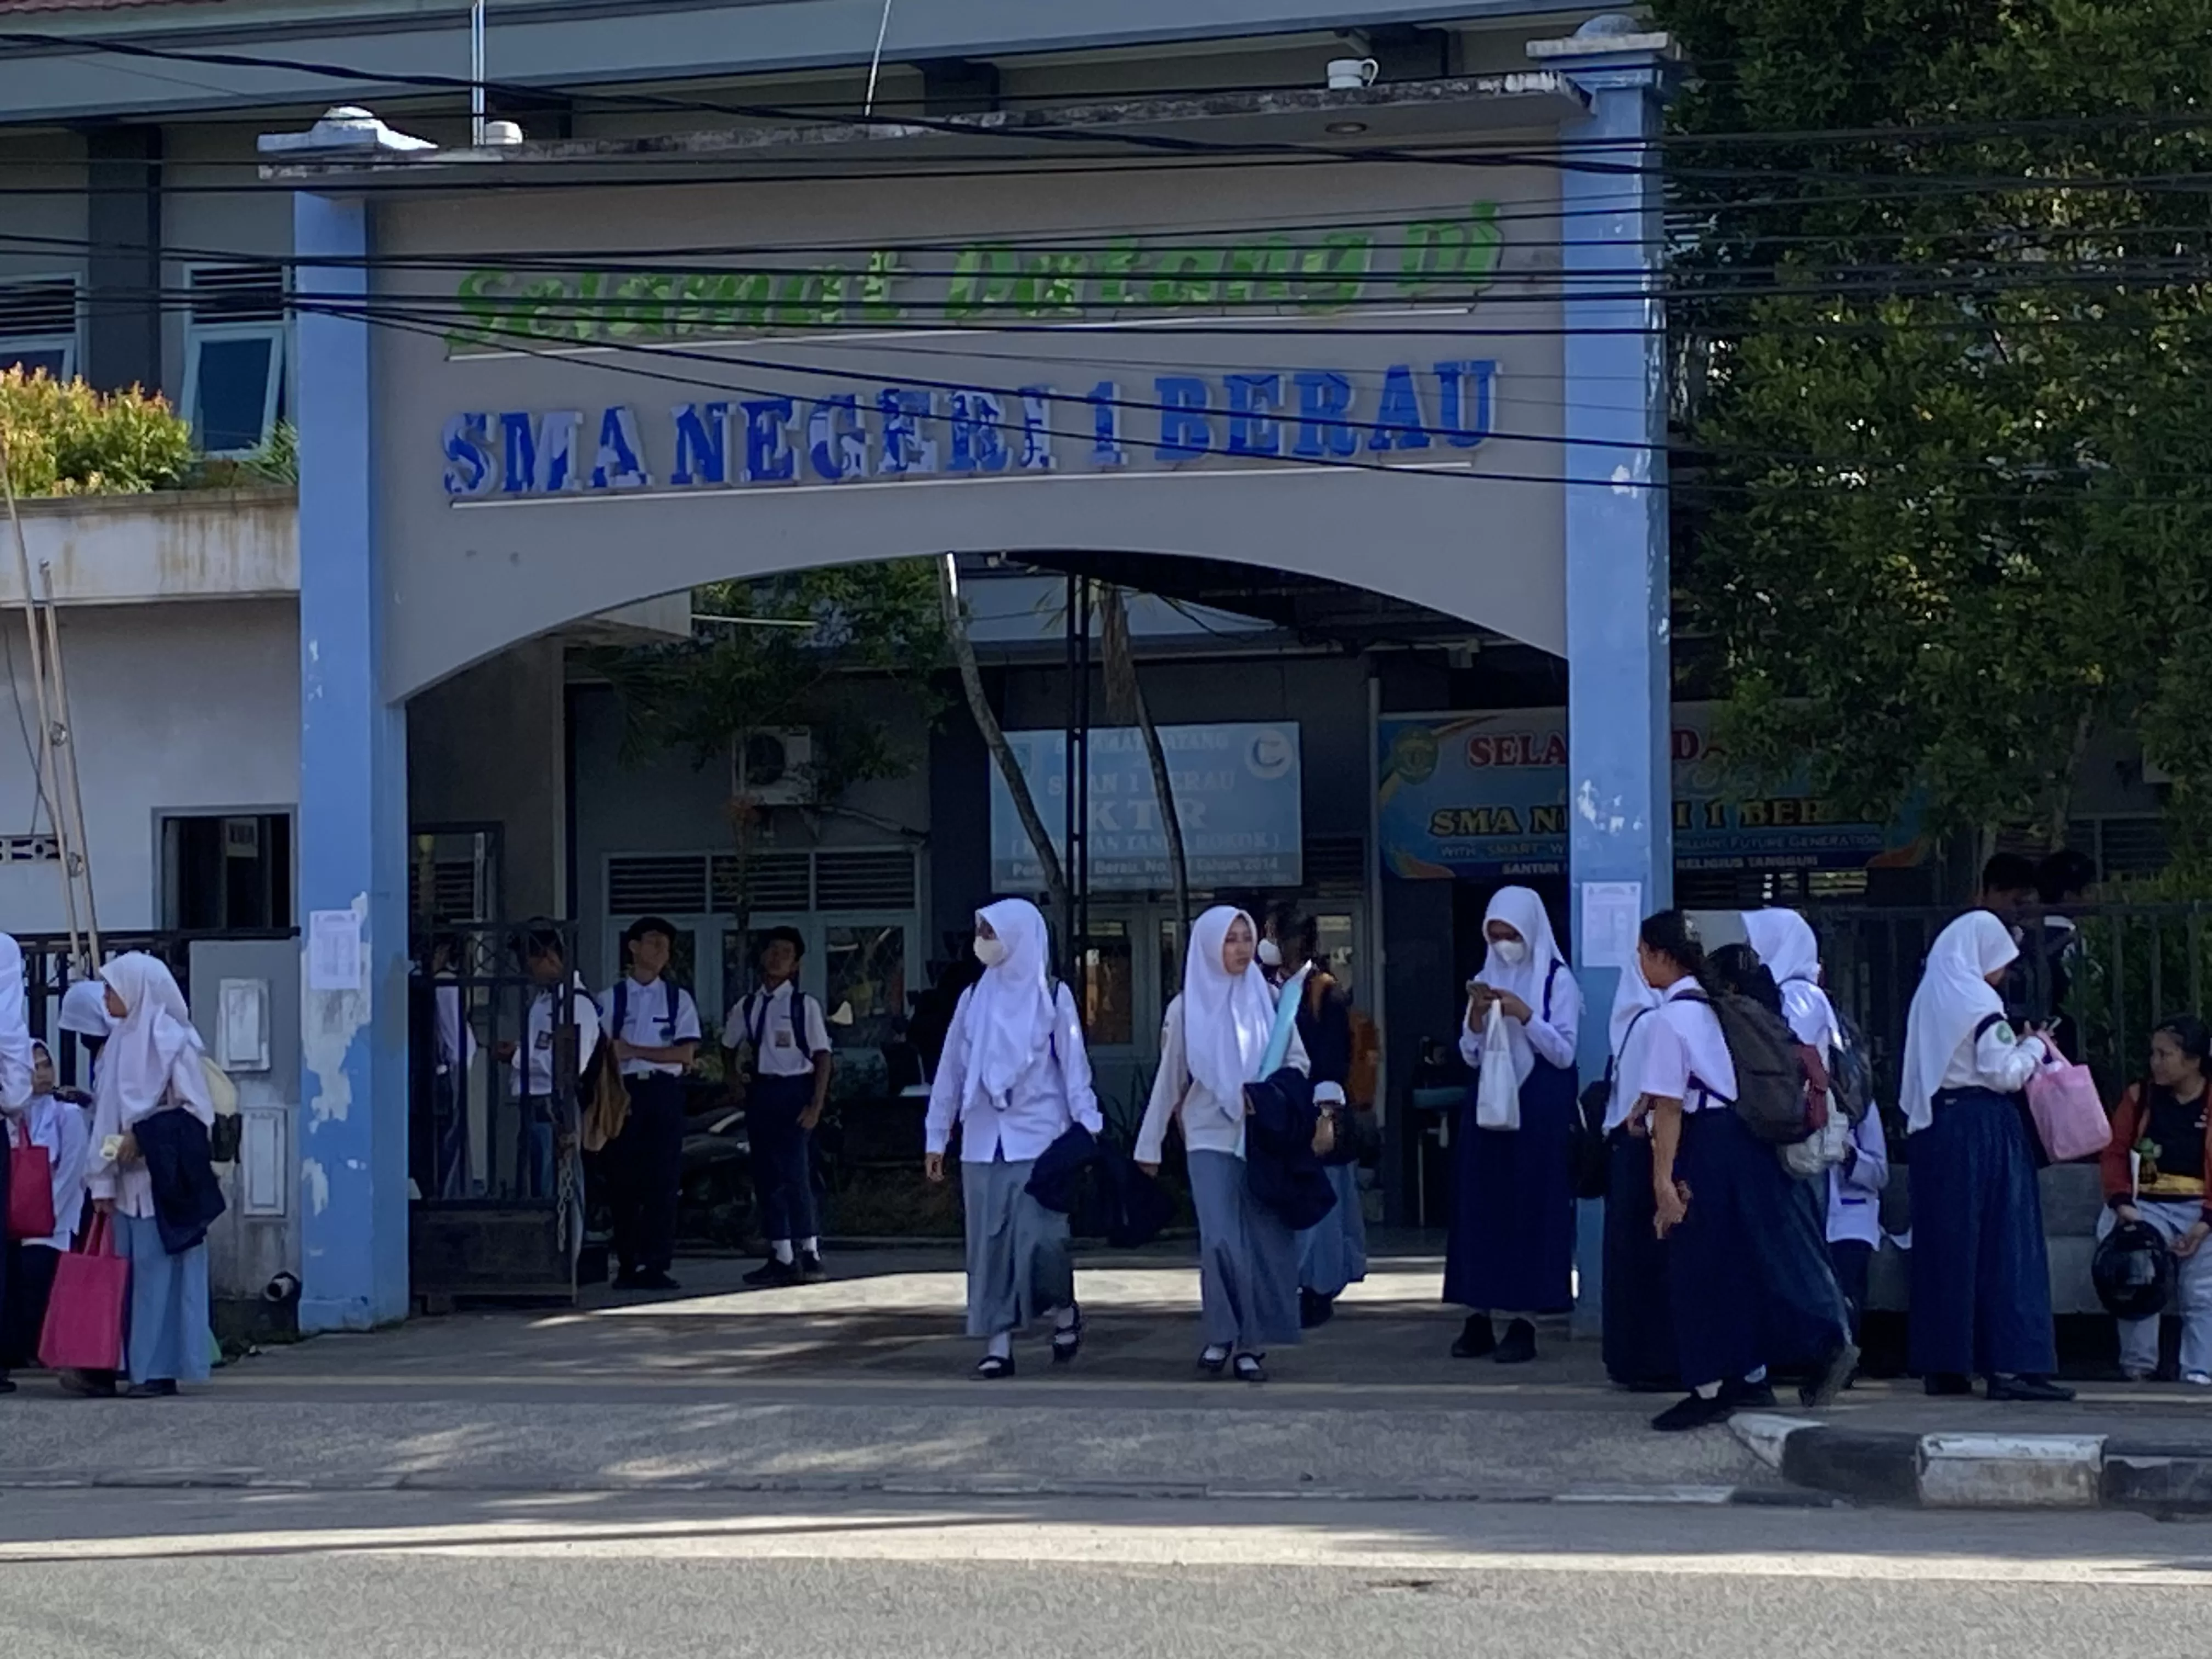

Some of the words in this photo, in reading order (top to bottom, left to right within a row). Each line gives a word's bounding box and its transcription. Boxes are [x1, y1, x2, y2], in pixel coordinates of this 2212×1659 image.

[443, 405, 653, 496] SMA
[669, 383, 1057, 486] NEGERI
[1087, 381, 1128, 467] 1
[1153, 360, 1502, 461] BERAU
[1467, 732, 1567, 768] SELA
[1090, 798, 1207, 832] KTR
[1430, 807, 1522, 836] SMA
